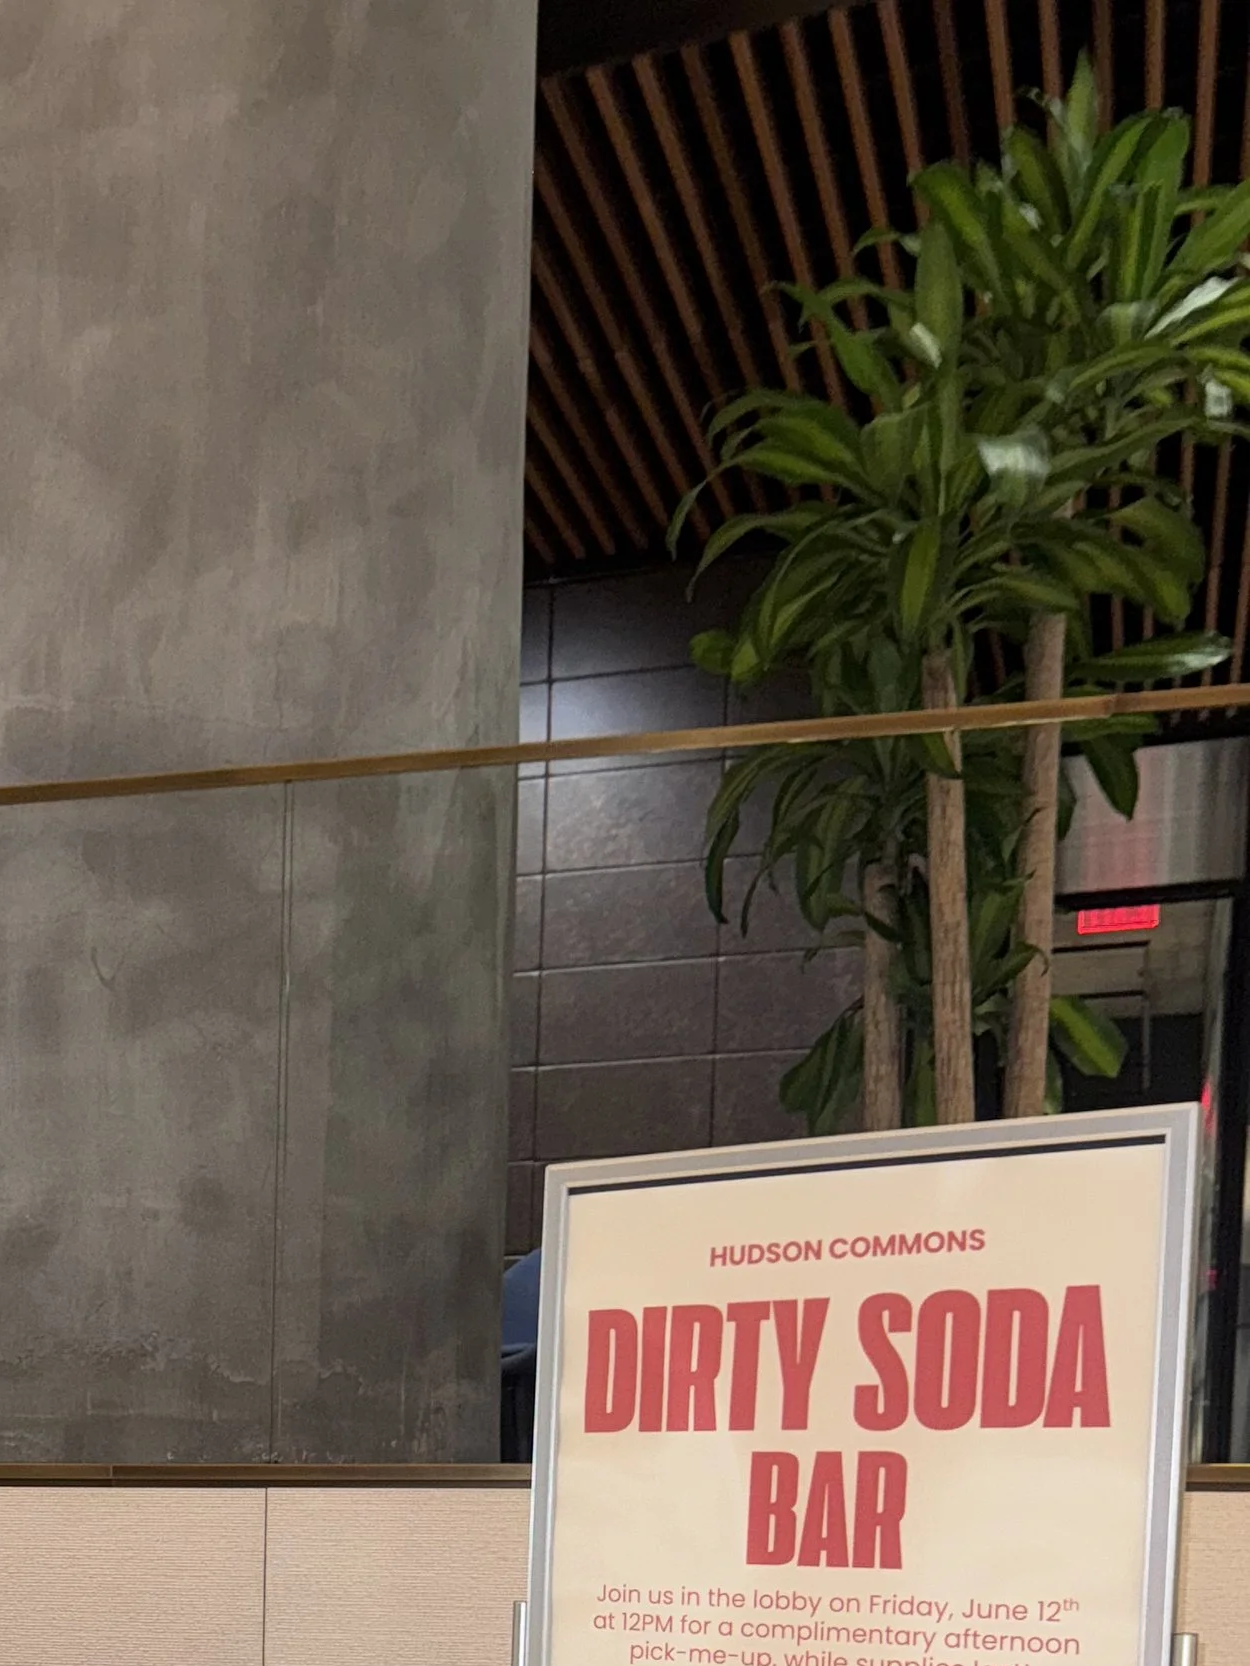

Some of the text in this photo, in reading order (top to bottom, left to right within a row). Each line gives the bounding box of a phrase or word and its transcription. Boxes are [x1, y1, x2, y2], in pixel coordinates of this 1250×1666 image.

[709, 1229, 986, 1267] HUDSON COMMONS
[584, 1284, 1111, 1433] DIRTY SODA
[746, 1450, 908, 1570] BAR
[596, 1584, 641, 1603] Join
[648, 1589, 674, 1605] us
[681, 1586, 700, 1606] in
[708, 1588, 745, 1608] the
[753, 1590, 822, 1617] lobby
[829, 1596, 861, 1613] on
[869, 1594, 954, 1623] Friday,
[962, 1599, 1028, 1621] June
[593, 1612, 1080, 1655] at 12PM for a complimentary afternoon
